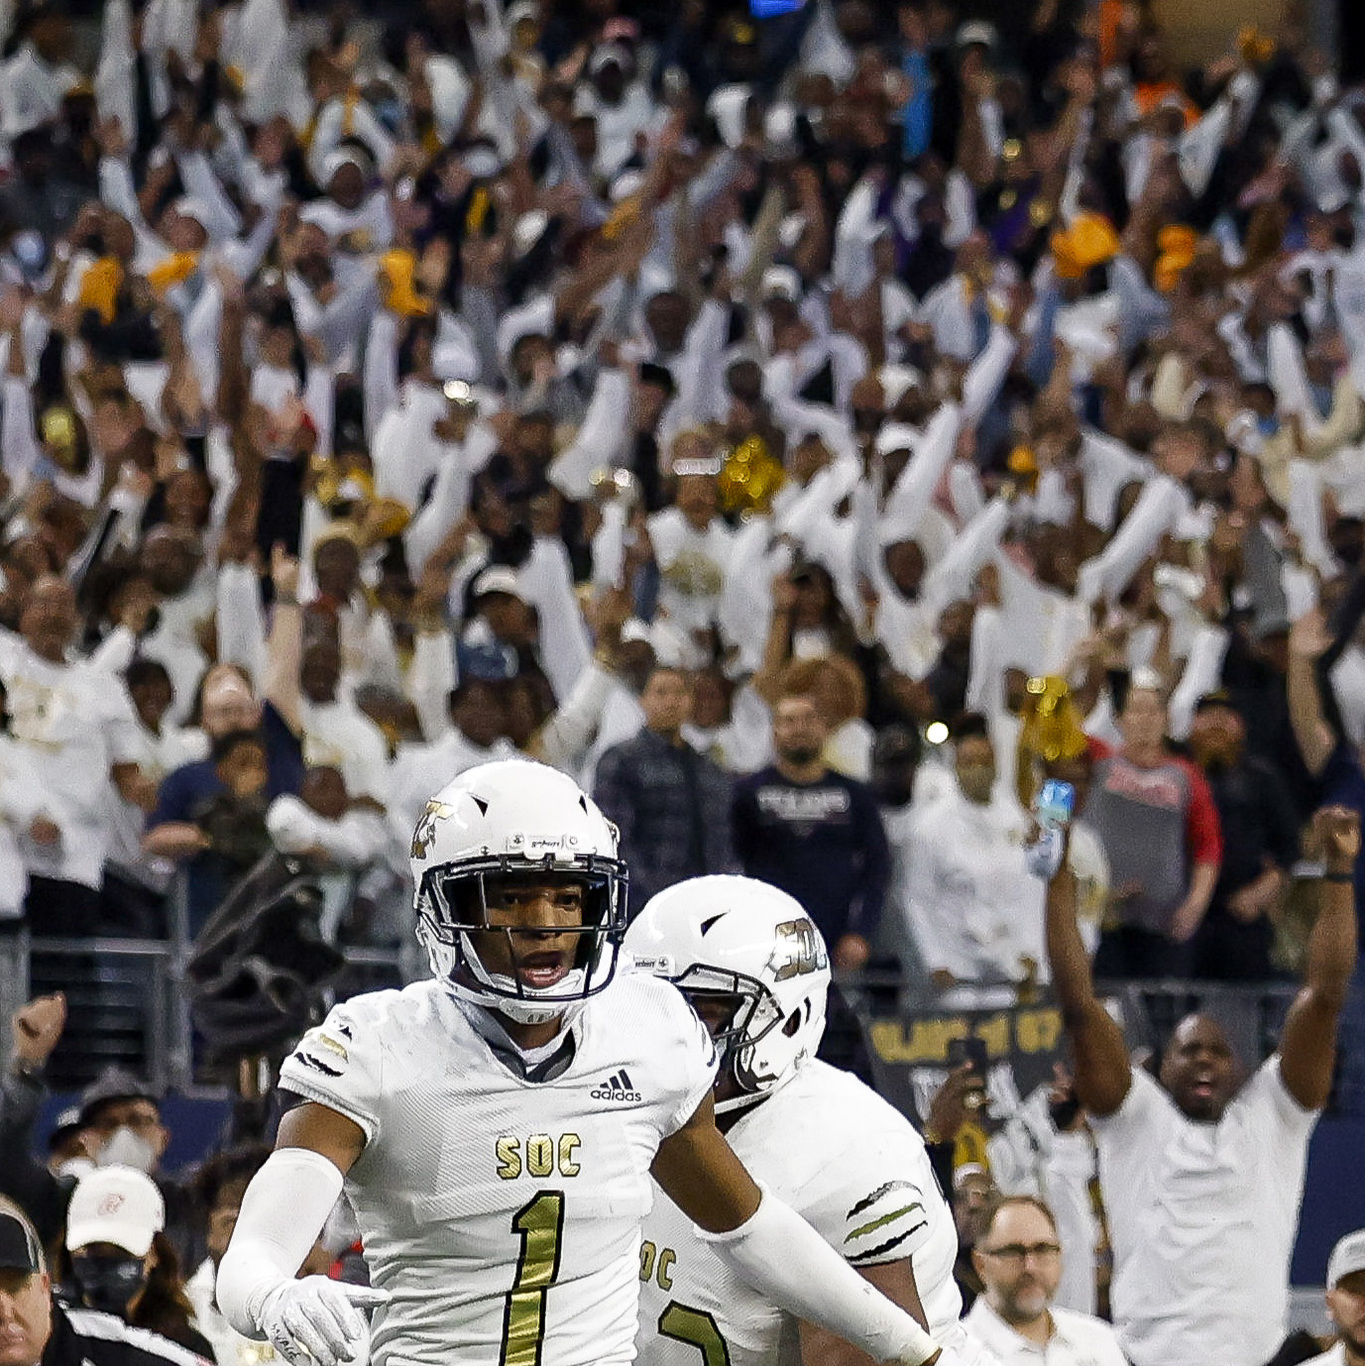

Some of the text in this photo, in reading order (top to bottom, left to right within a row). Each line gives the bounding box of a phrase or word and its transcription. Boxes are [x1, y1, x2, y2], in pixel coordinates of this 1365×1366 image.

[590, 1089, 642, 1102] adidas
[495, 1132, 582, 1181] SOC
[639, 1239, 677, 1292] OC
